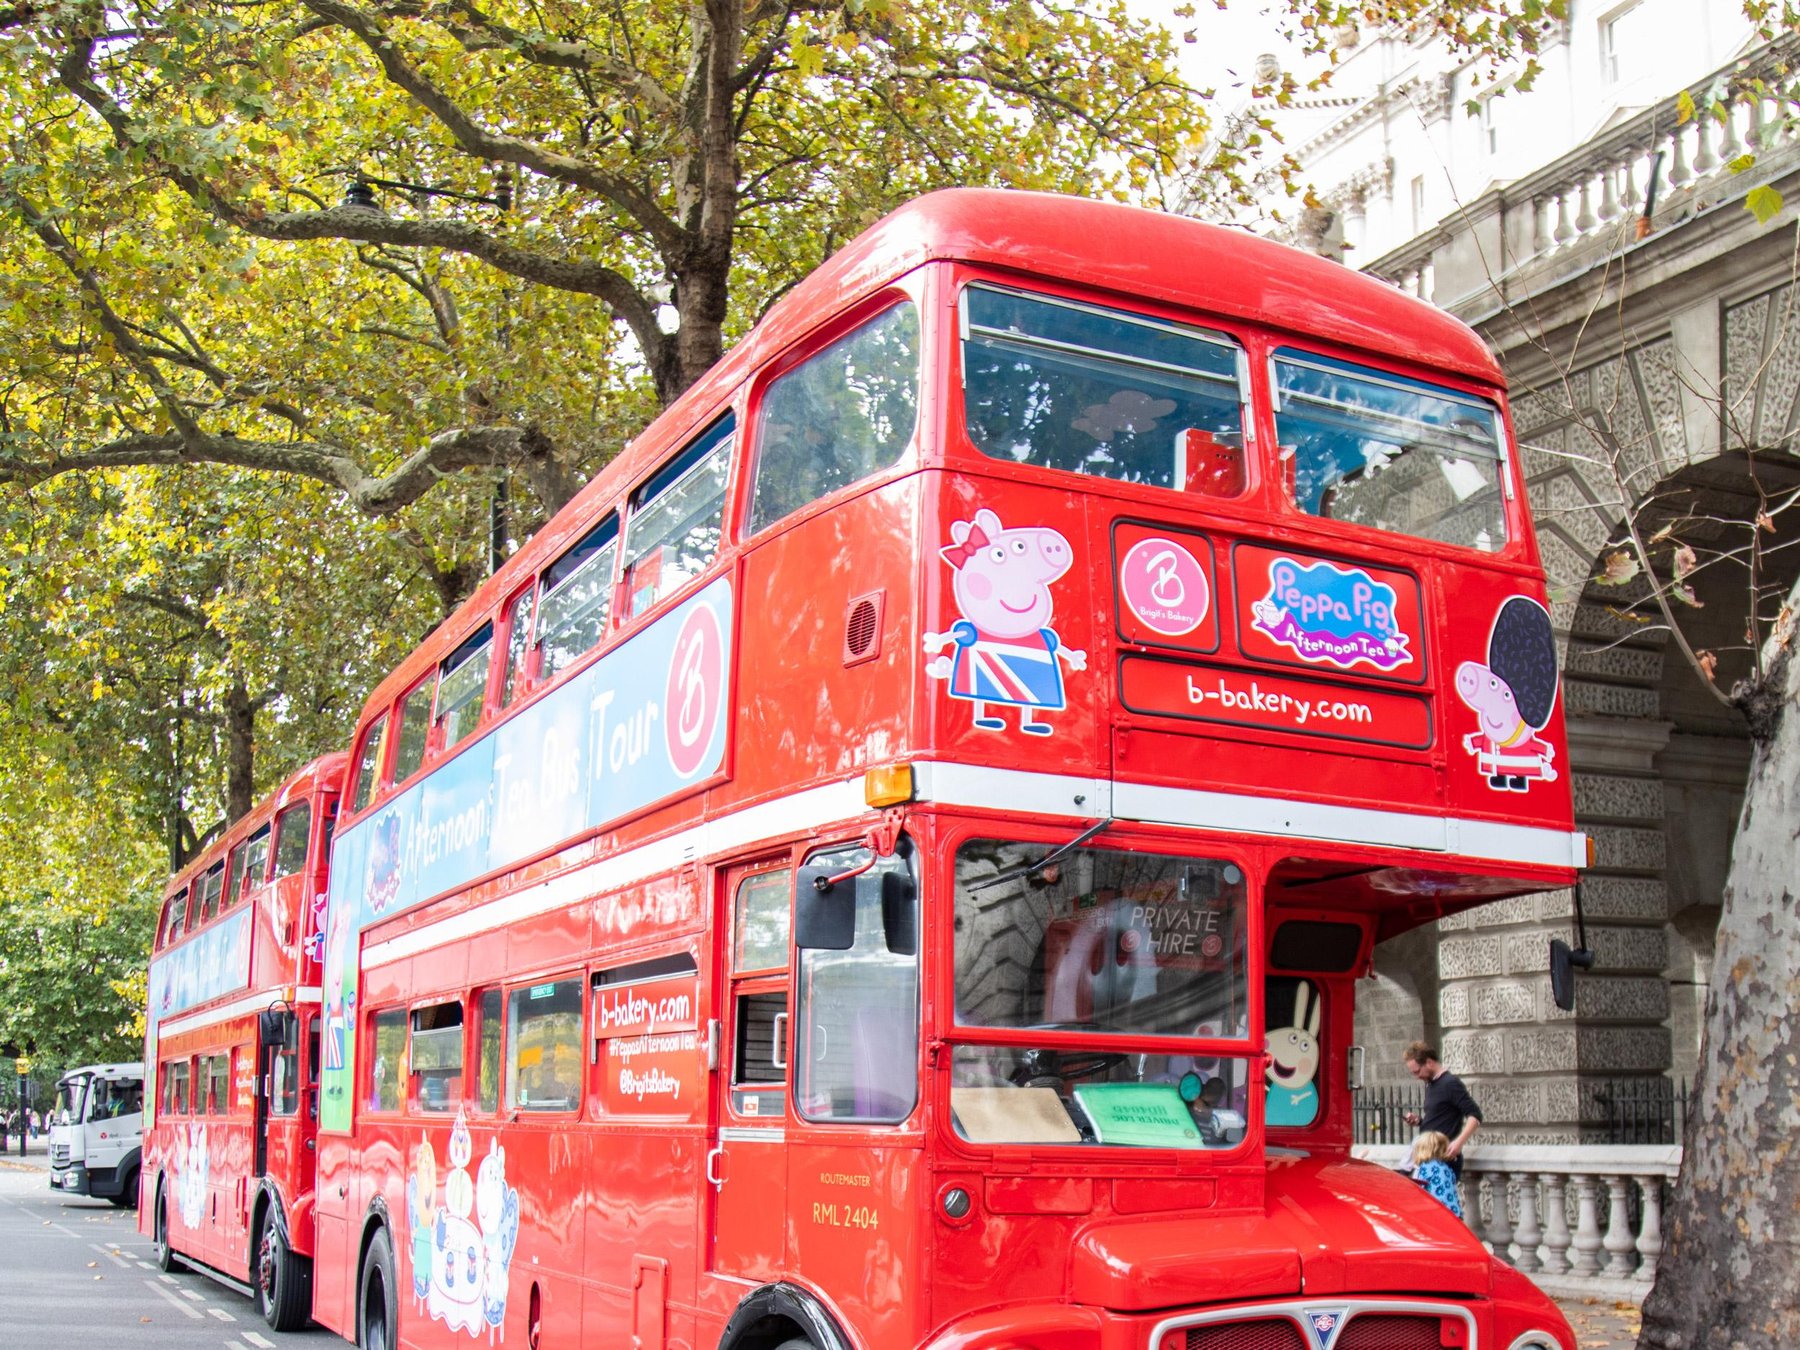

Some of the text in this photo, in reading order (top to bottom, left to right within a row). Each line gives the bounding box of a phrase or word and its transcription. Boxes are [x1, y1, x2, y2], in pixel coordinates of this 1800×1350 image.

[1139, 605, 1195, 625] Brigit's Bakery
[1275, 565, 1390, 631] Peppa Pig
[1285, 623, 1386, 657] Afternoon Tea
[1186, 674, 1373, 724] b-bakery.com
[402, 796, 486, 880] Afternoon
[494, 753, 533, 828] Tea
[541, 727, 581, 807] Bus
[591, 690, 660, 781] Tour
[1130, 906, 1221, 932] PRIVATE
[1146, 933, 1198, 955] HIRE
[600, 988, 691, 1034] b-bakery.com
[619, 1067, 681, 1102] @BrigitsBakery
[819, 1172, 871, 1187] ROUTEMASTER
[813, 1202, 879, 1231] RML 2404
